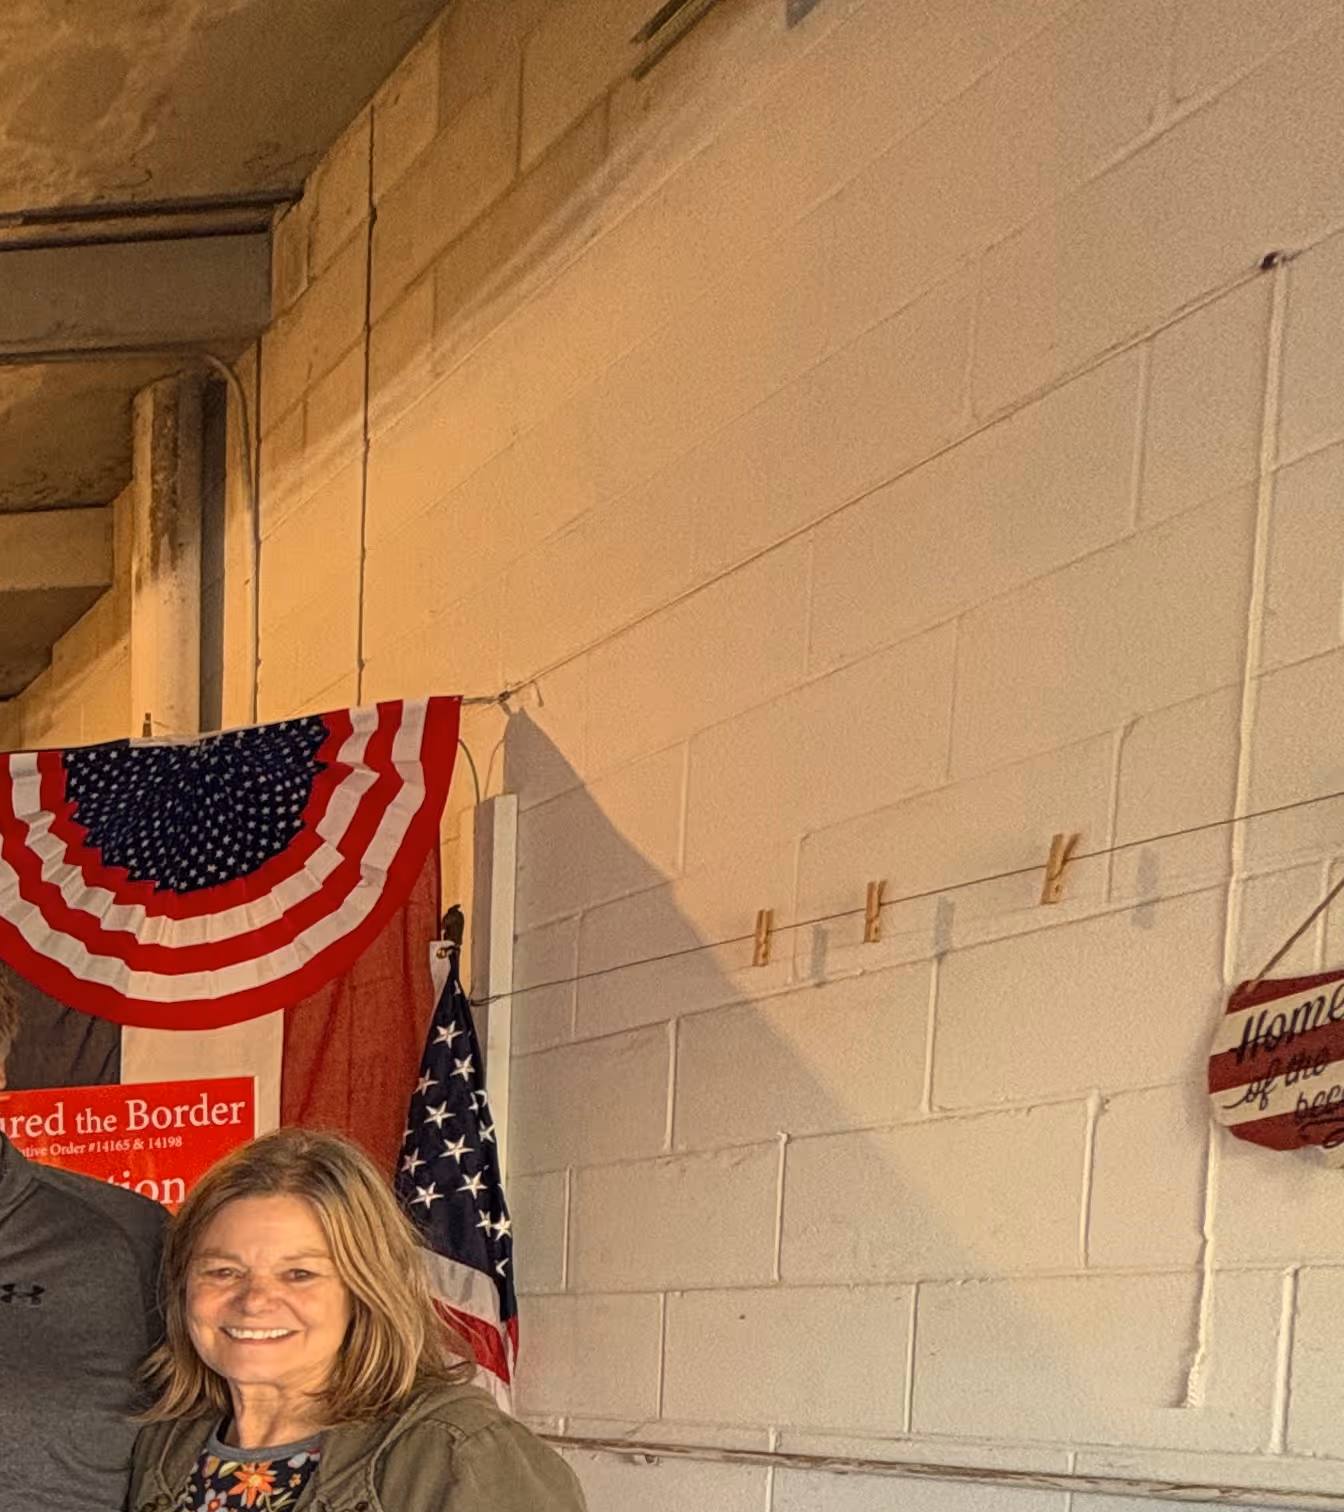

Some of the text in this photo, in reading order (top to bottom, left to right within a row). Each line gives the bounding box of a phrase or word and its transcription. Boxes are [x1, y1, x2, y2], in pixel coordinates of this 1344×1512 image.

[75, 1107, 117, 1134] the
[125, 1093, 246, 1131] Border
[50, 1142, 86, 1156] Order
[88, 1138, 130, 1154] #14165
[133, 1139, 144, 1150] &
[148, 1136, 183, 1150] 14198
